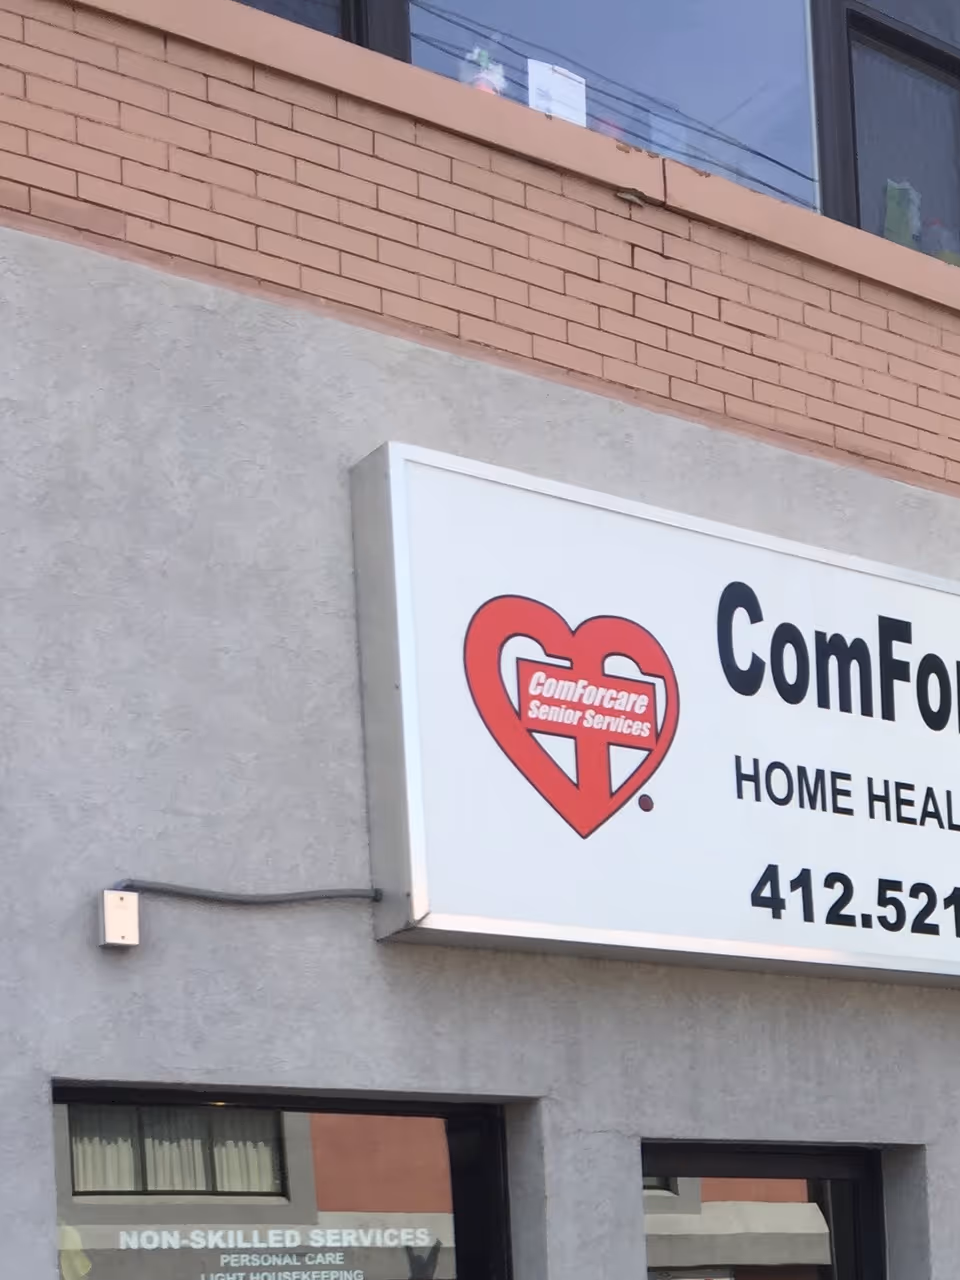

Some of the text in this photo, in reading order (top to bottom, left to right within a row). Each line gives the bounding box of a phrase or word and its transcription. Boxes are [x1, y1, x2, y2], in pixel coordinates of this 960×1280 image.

[528, 671, 649, 714] ComForcare
[528, 700, 651, 737] Senior Services
[734, 755, 854, 817] HOME
[119, 1228, 430, 1249] NON-SKILLED SERVICES
[220, 1252, 344, 1267] PERSONAL CARE
